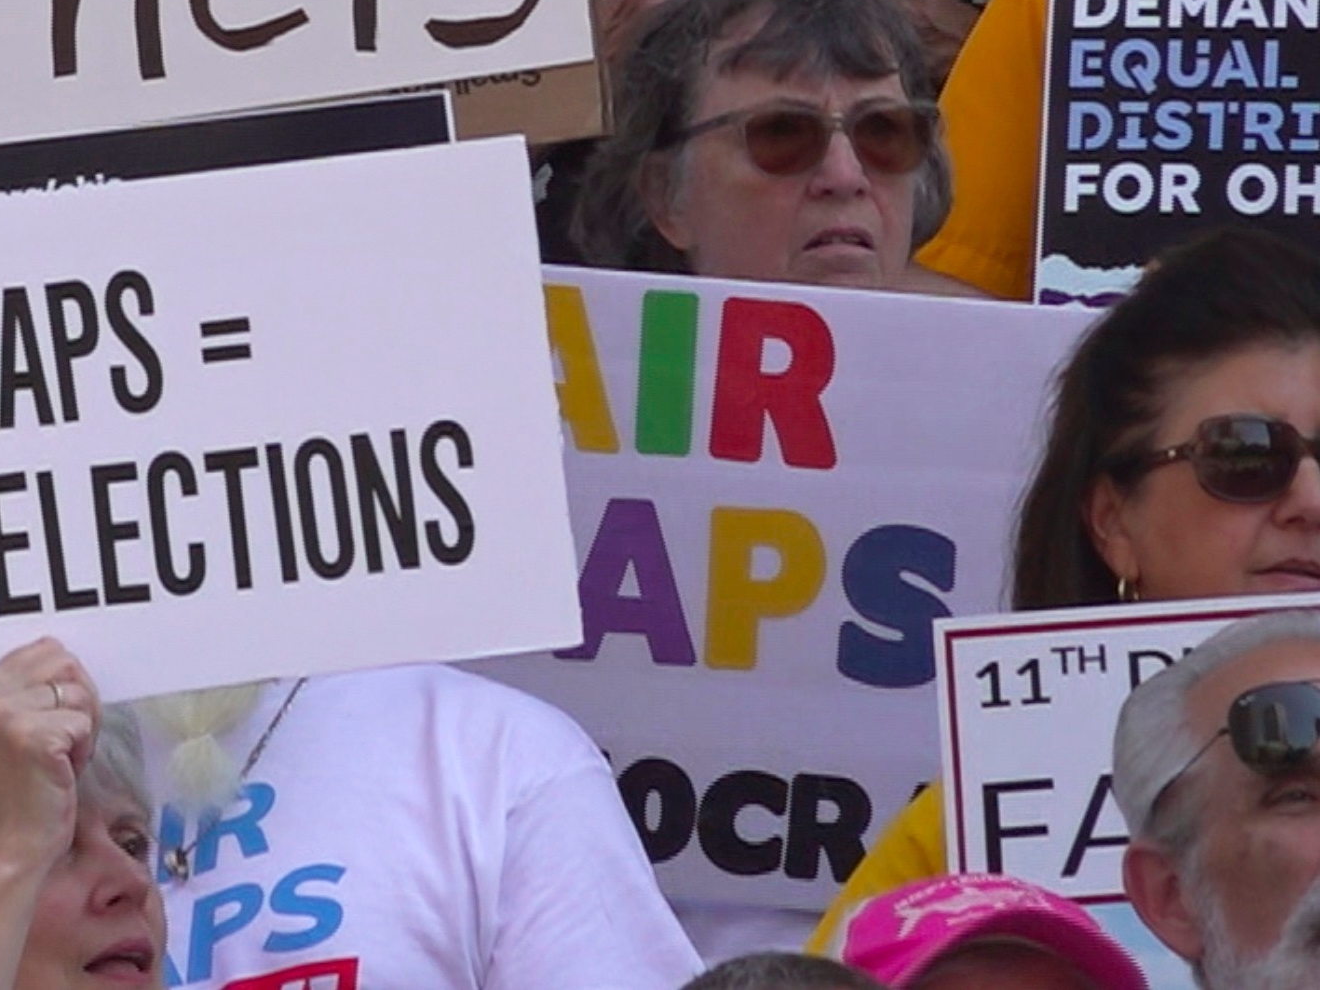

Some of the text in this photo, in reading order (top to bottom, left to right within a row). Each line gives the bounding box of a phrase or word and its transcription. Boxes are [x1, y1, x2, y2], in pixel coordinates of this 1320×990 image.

[1068, 38, 1300, 95] EQUAL
[1063, 162, 1202, 213] FOR
[975, 643, 1108, 709] 11TH
[603, 750, 928, 883] OCR
[163, 864, 346, 987] PS
